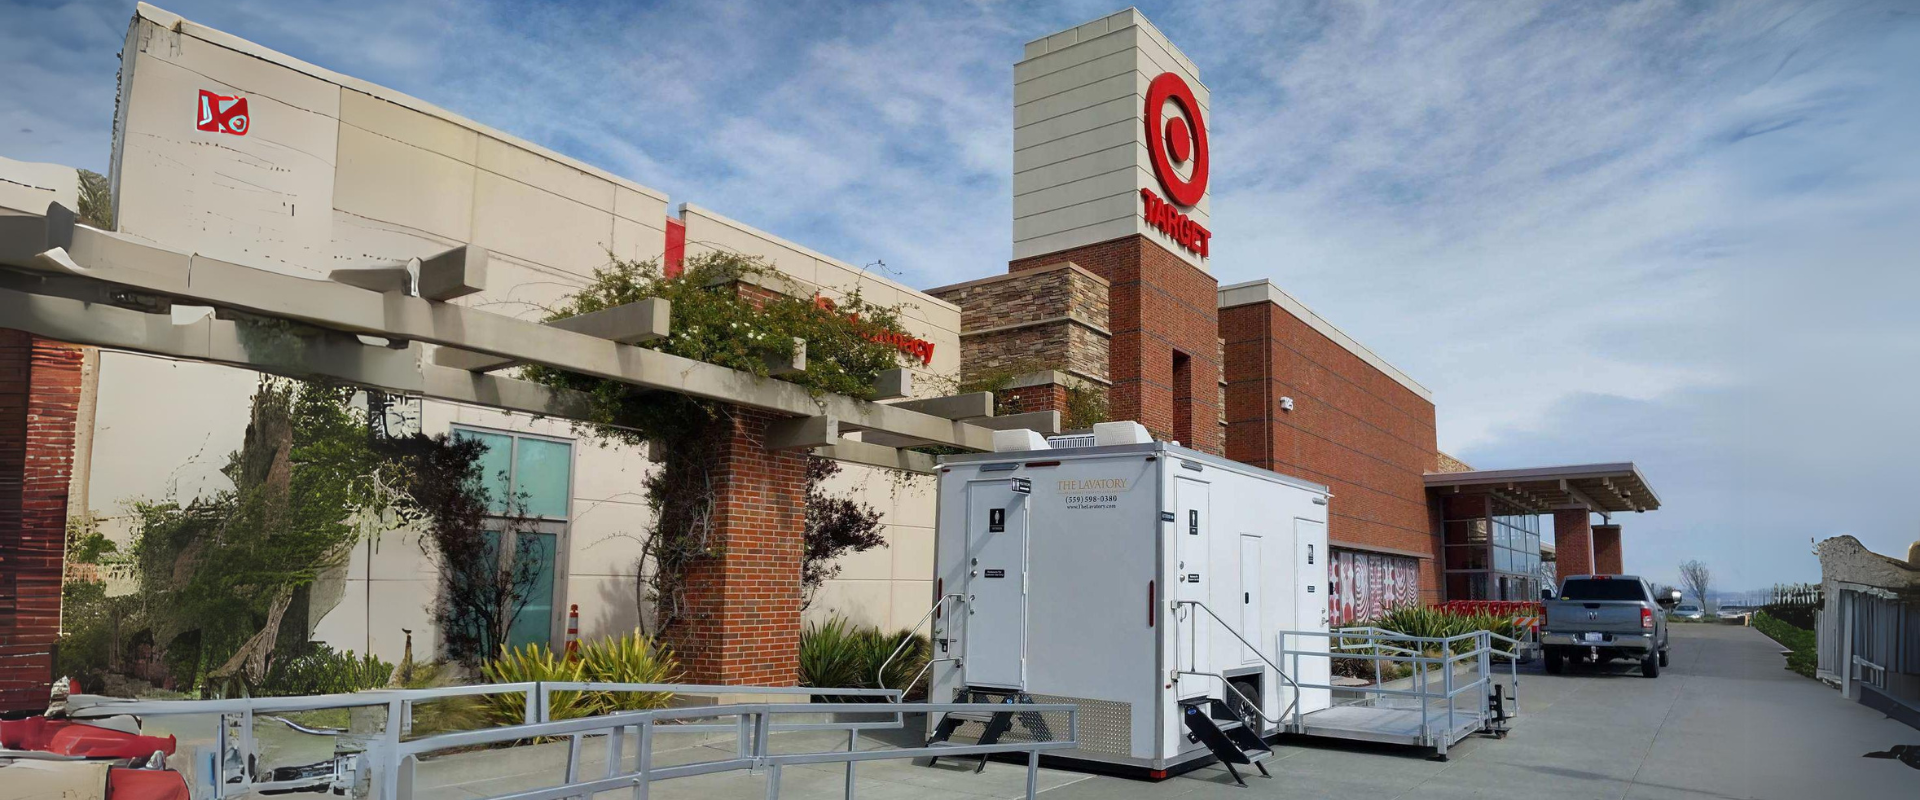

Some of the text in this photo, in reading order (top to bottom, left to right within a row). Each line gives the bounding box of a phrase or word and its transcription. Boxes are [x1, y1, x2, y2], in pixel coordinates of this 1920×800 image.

[1140, 187, 1212, 258] TARGET
[1057, 479, 1127, 491] THE LAVATORY
